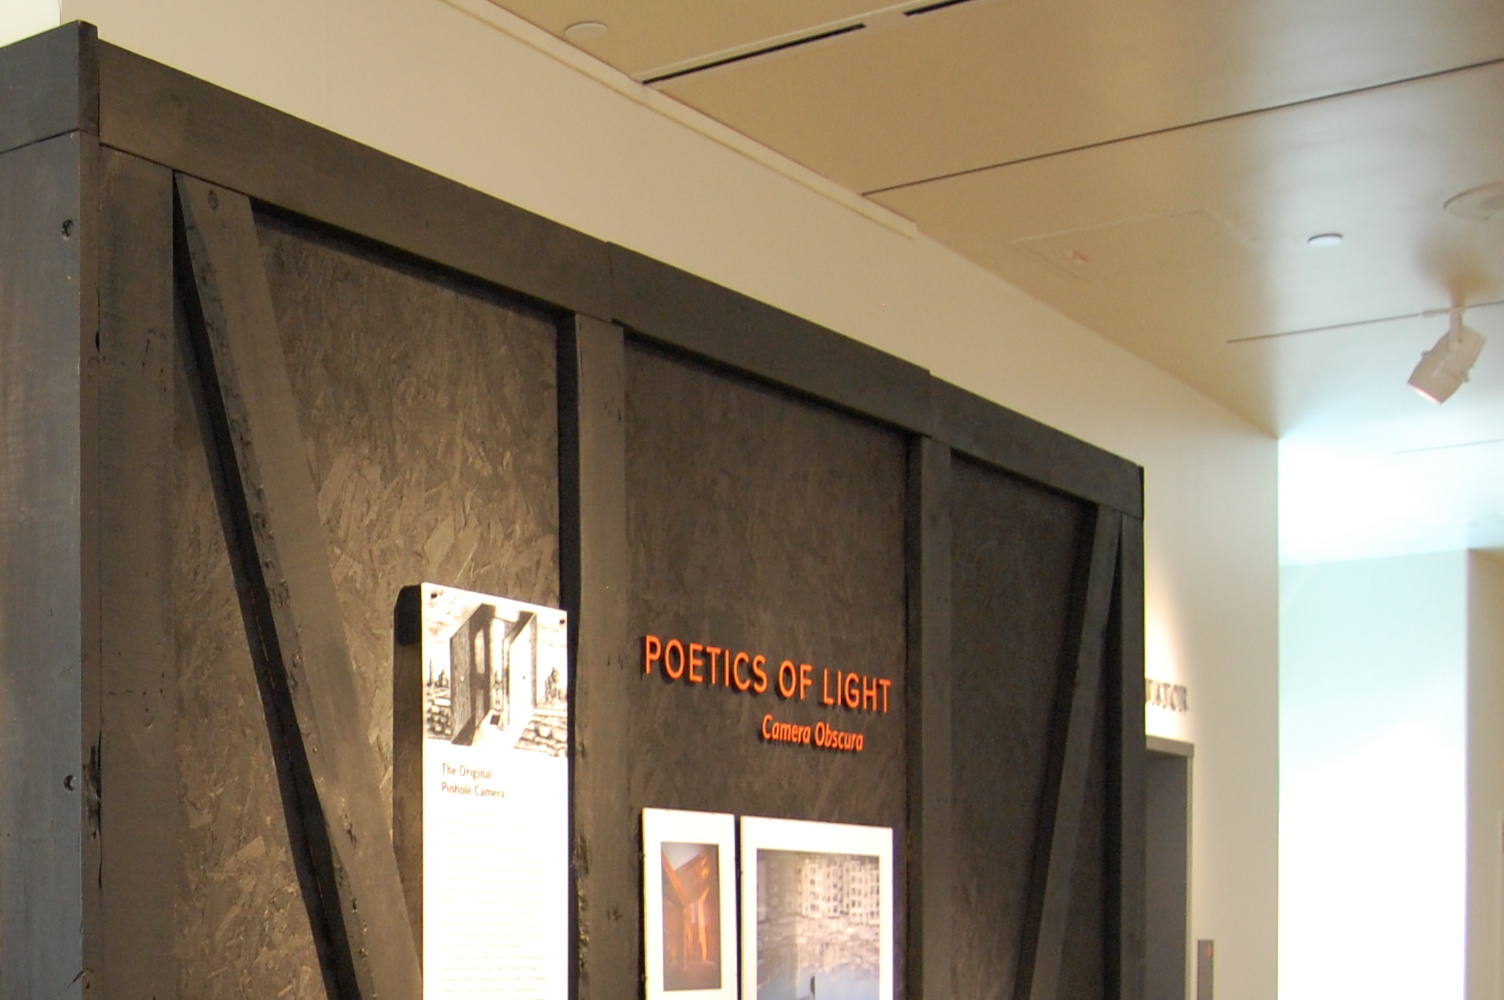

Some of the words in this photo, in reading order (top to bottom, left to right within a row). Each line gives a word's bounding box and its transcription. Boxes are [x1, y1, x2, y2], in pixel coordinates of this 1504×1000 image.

[646, 634, 768, 693] POETICS
[778, 660, 814, 700] OF
[823, 668, 892, 714] LIGHT
[762, 713, 812, 744] Camera
[814, 721, 864, 752] Obscura
[442, 763, 456, 775] The
[459, 765, 492, 780] Original
[441, 781, 472, 795] Pinhole
[475, 785, 506, 798] Camera
